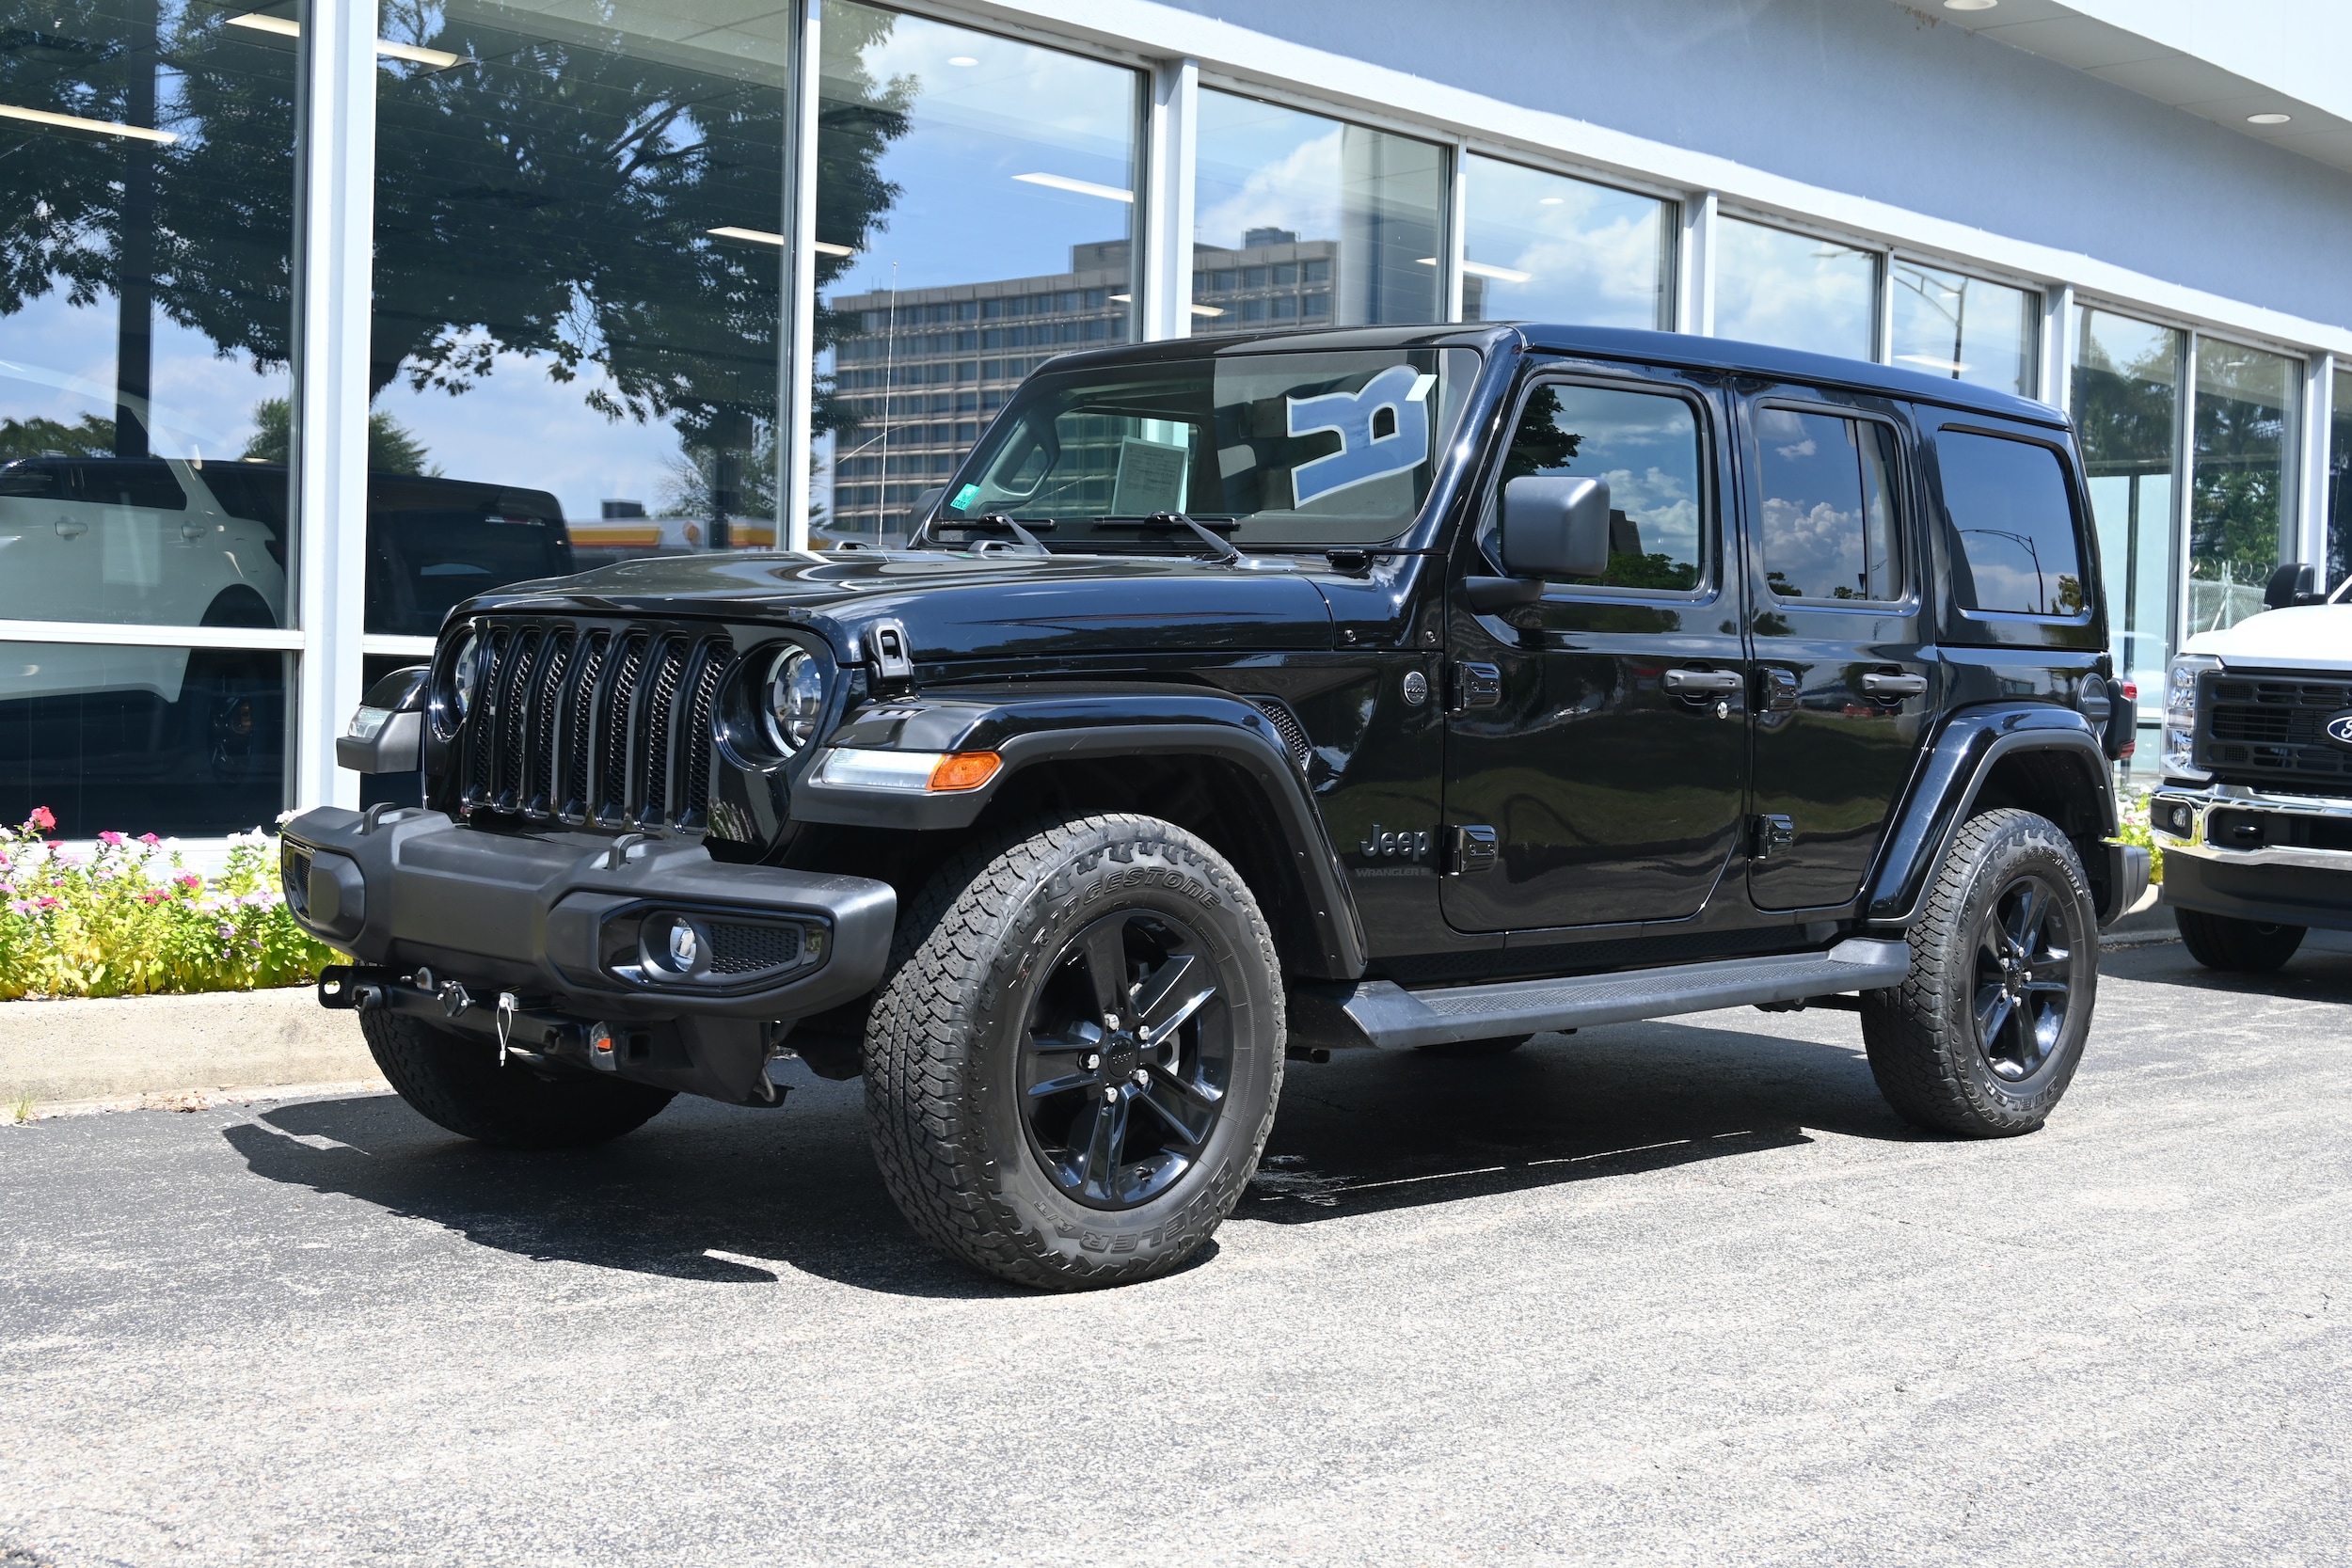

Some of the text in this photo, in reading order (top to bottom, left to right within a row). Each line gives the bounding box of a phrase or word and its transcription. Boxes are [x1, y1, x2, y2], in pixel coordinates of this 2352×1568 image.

[1360, 824, 1430, 863] Jeep
[1355, 868, 1420, 878] WRANGLER
[1034, 1200, 1075, 1232] A/T
[1078, 1156, 1233, 1254] DUELER
